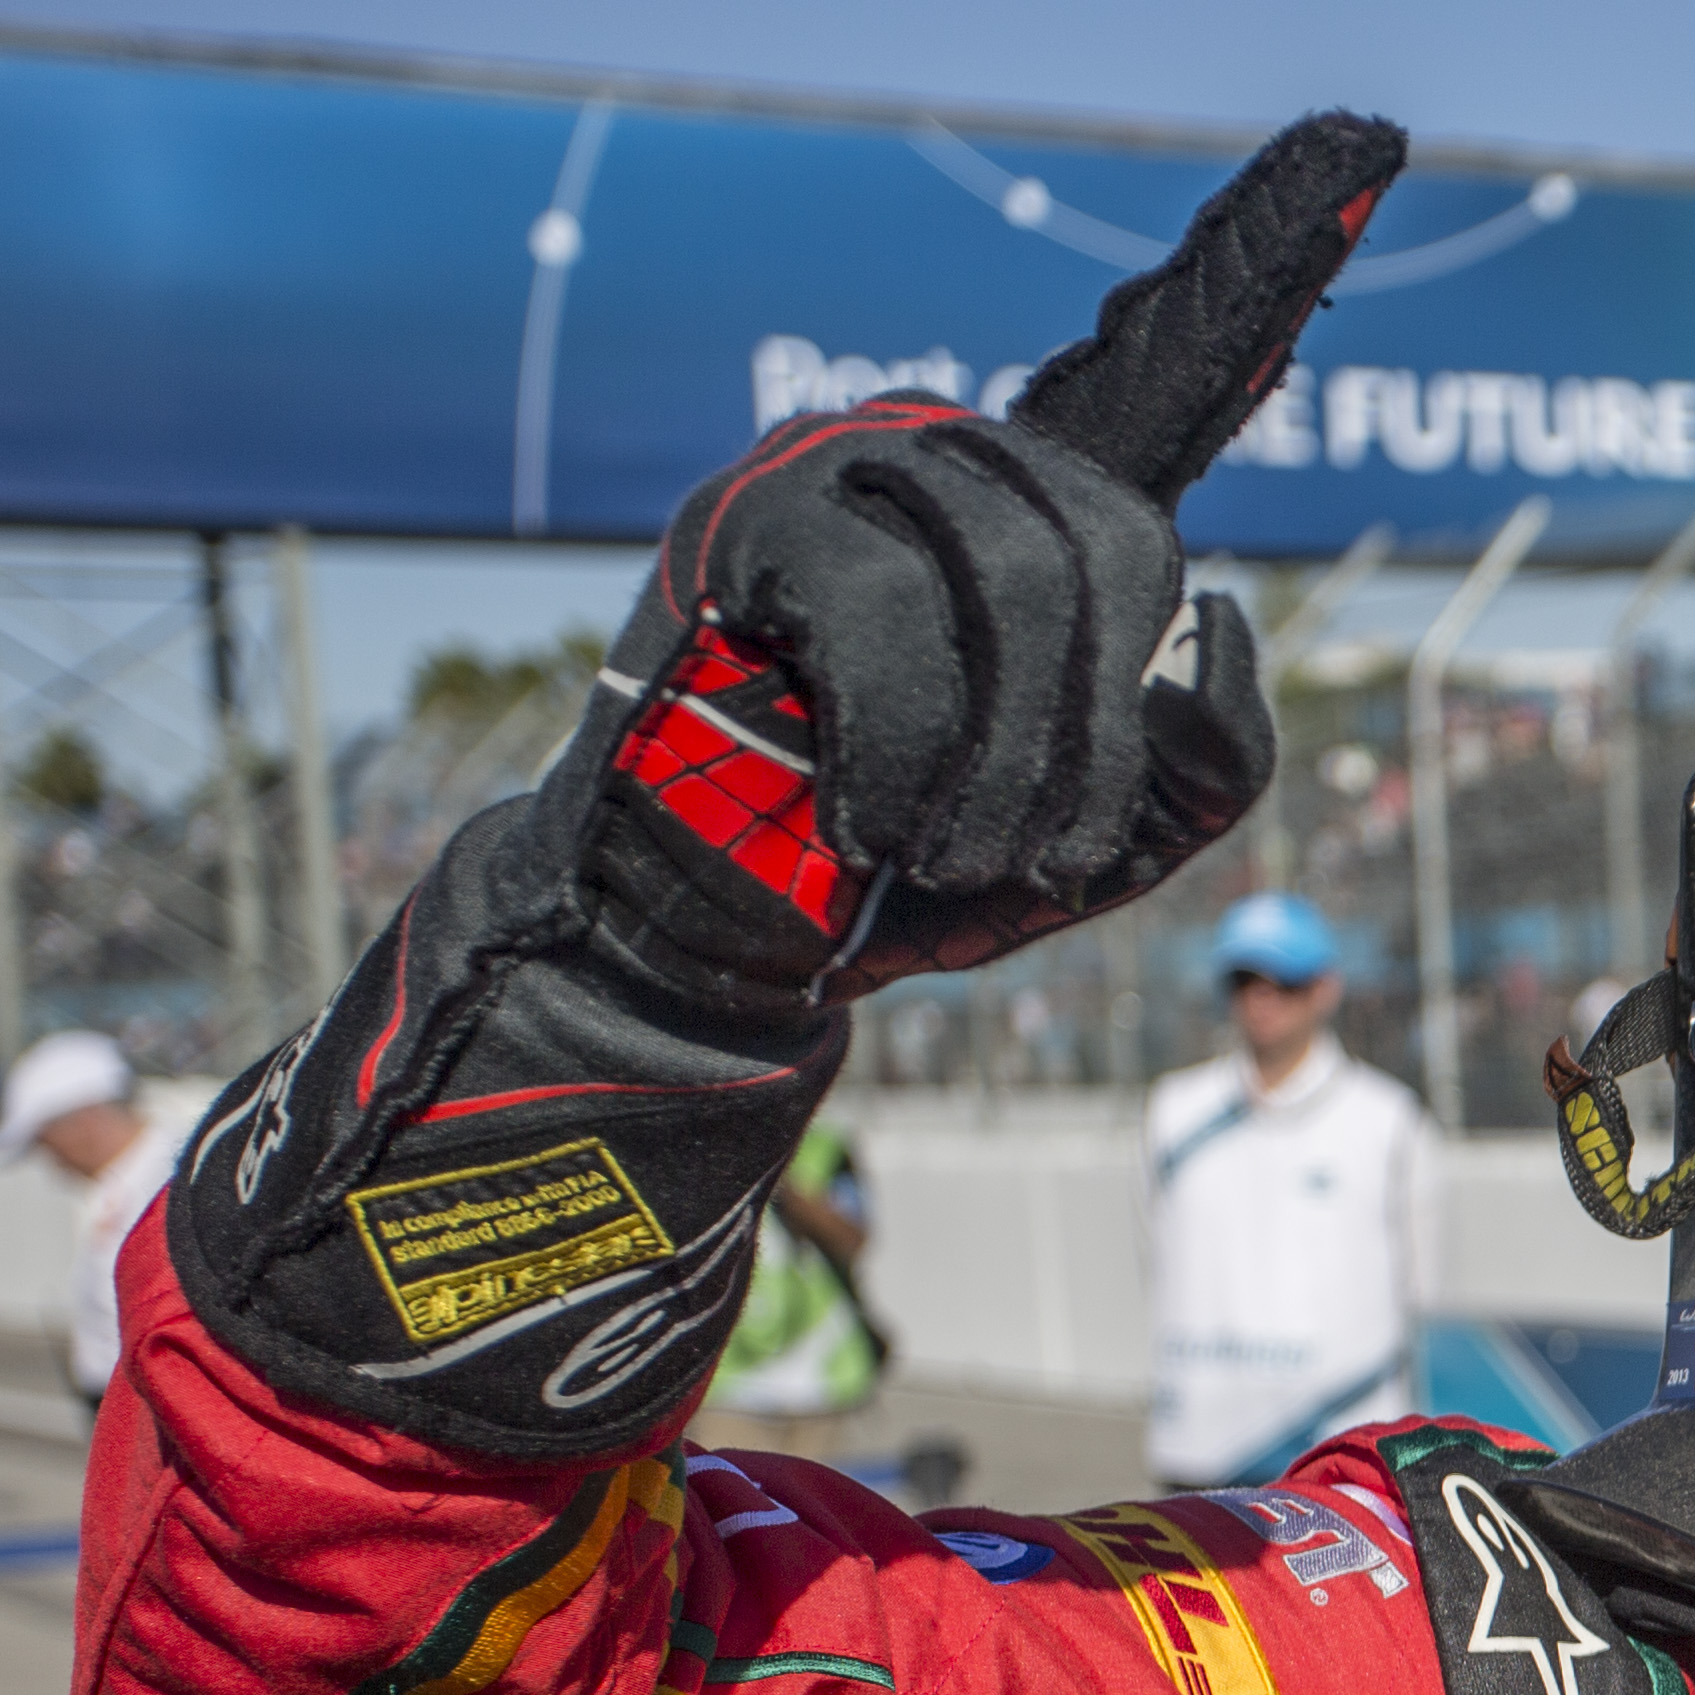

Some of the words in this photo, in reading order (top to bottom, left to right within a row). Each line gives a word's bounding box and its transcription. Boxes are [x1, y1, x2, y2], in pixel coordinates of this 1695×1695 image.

[402, 1198, 521, 1233] compliance
[390, 1221, 497, 1264] standard
[1667, 1368, 1690, 1387] 2013
